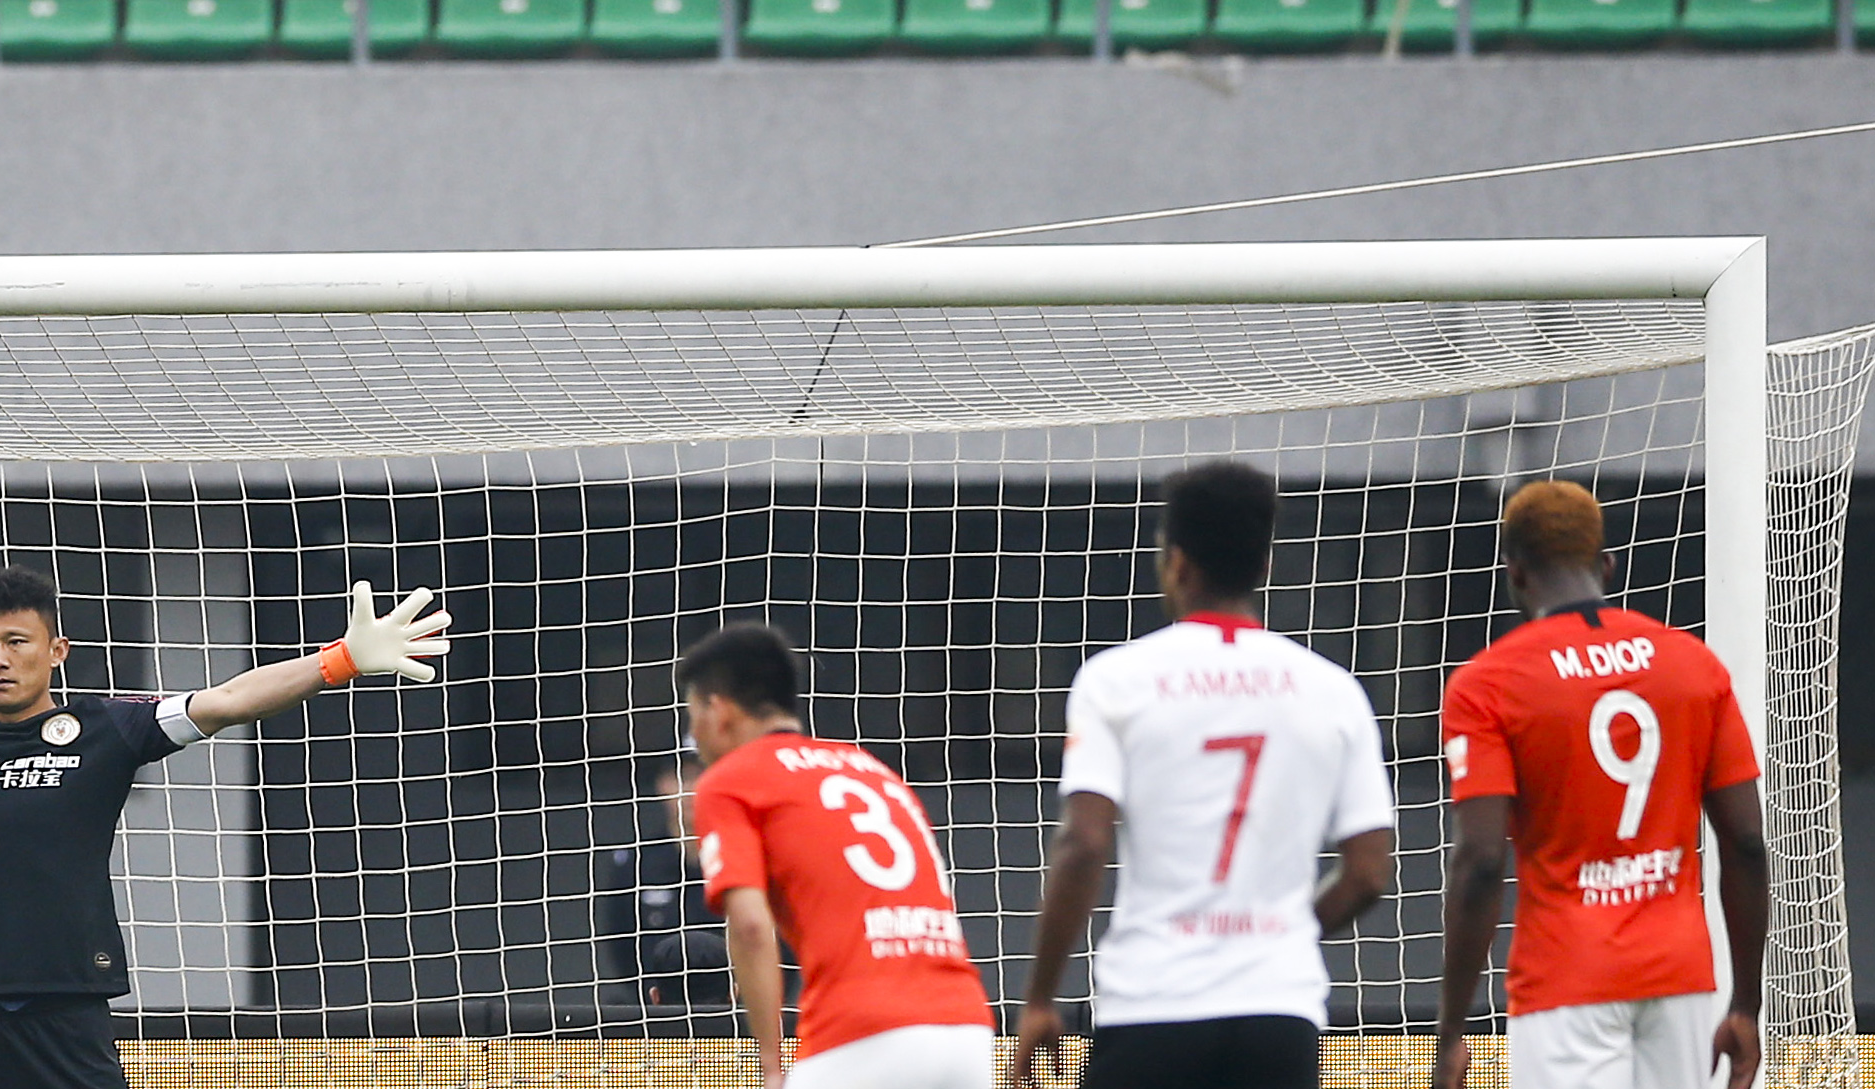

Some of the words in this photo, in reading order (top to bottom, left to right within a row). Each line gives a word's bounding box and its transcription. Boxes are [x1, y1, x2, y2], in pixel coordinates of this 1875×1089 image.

[1550, 637, 1656, 680] M.DIOP
[1203, 735, 1266, 885] 7
[1588, 689, 1661, 840] 9
[819, 774, 952, 898] 31
